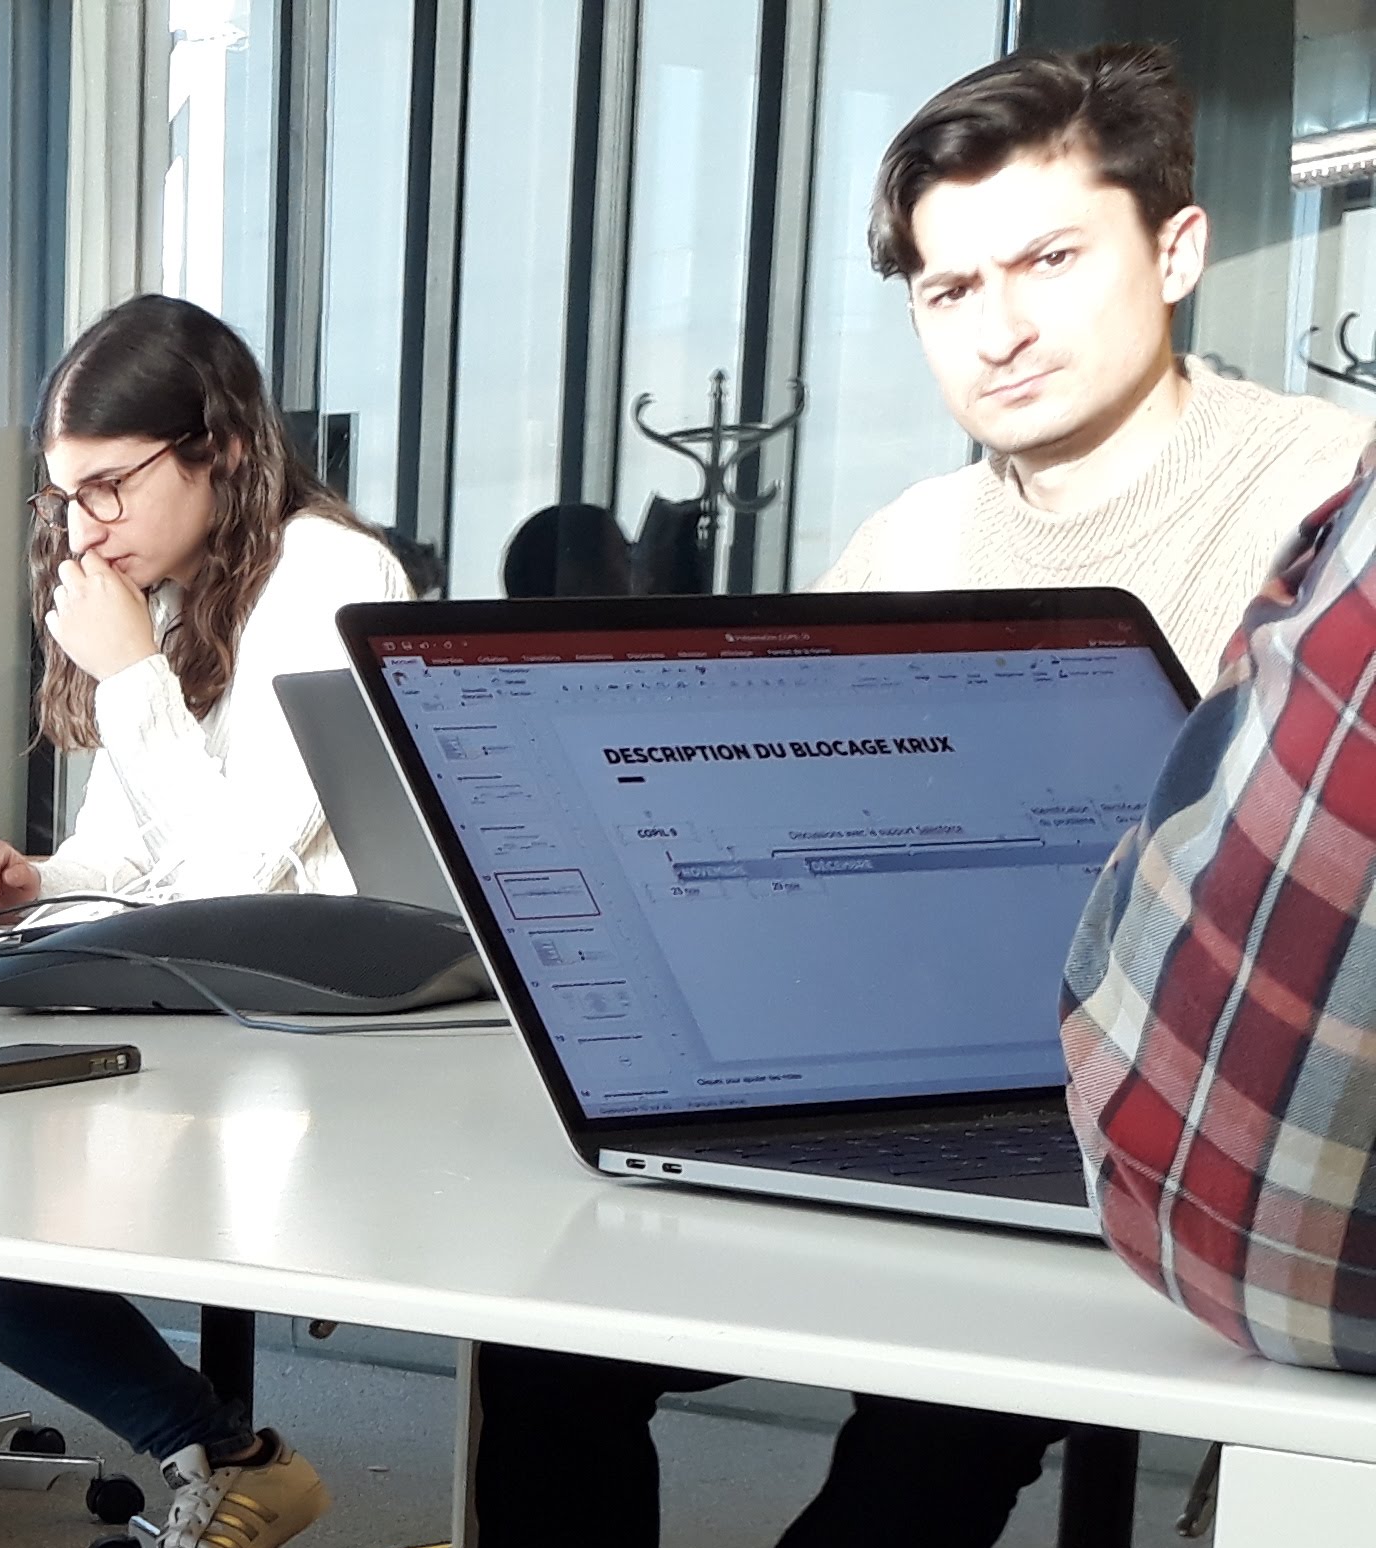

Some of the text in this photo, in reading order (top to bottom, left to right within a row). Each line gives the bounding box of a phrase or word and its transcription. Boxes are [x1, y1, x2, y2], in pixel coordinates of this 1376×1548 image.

[603, 735, 956, 765] DESCRIPTION DU BLOCAGE KRUX
